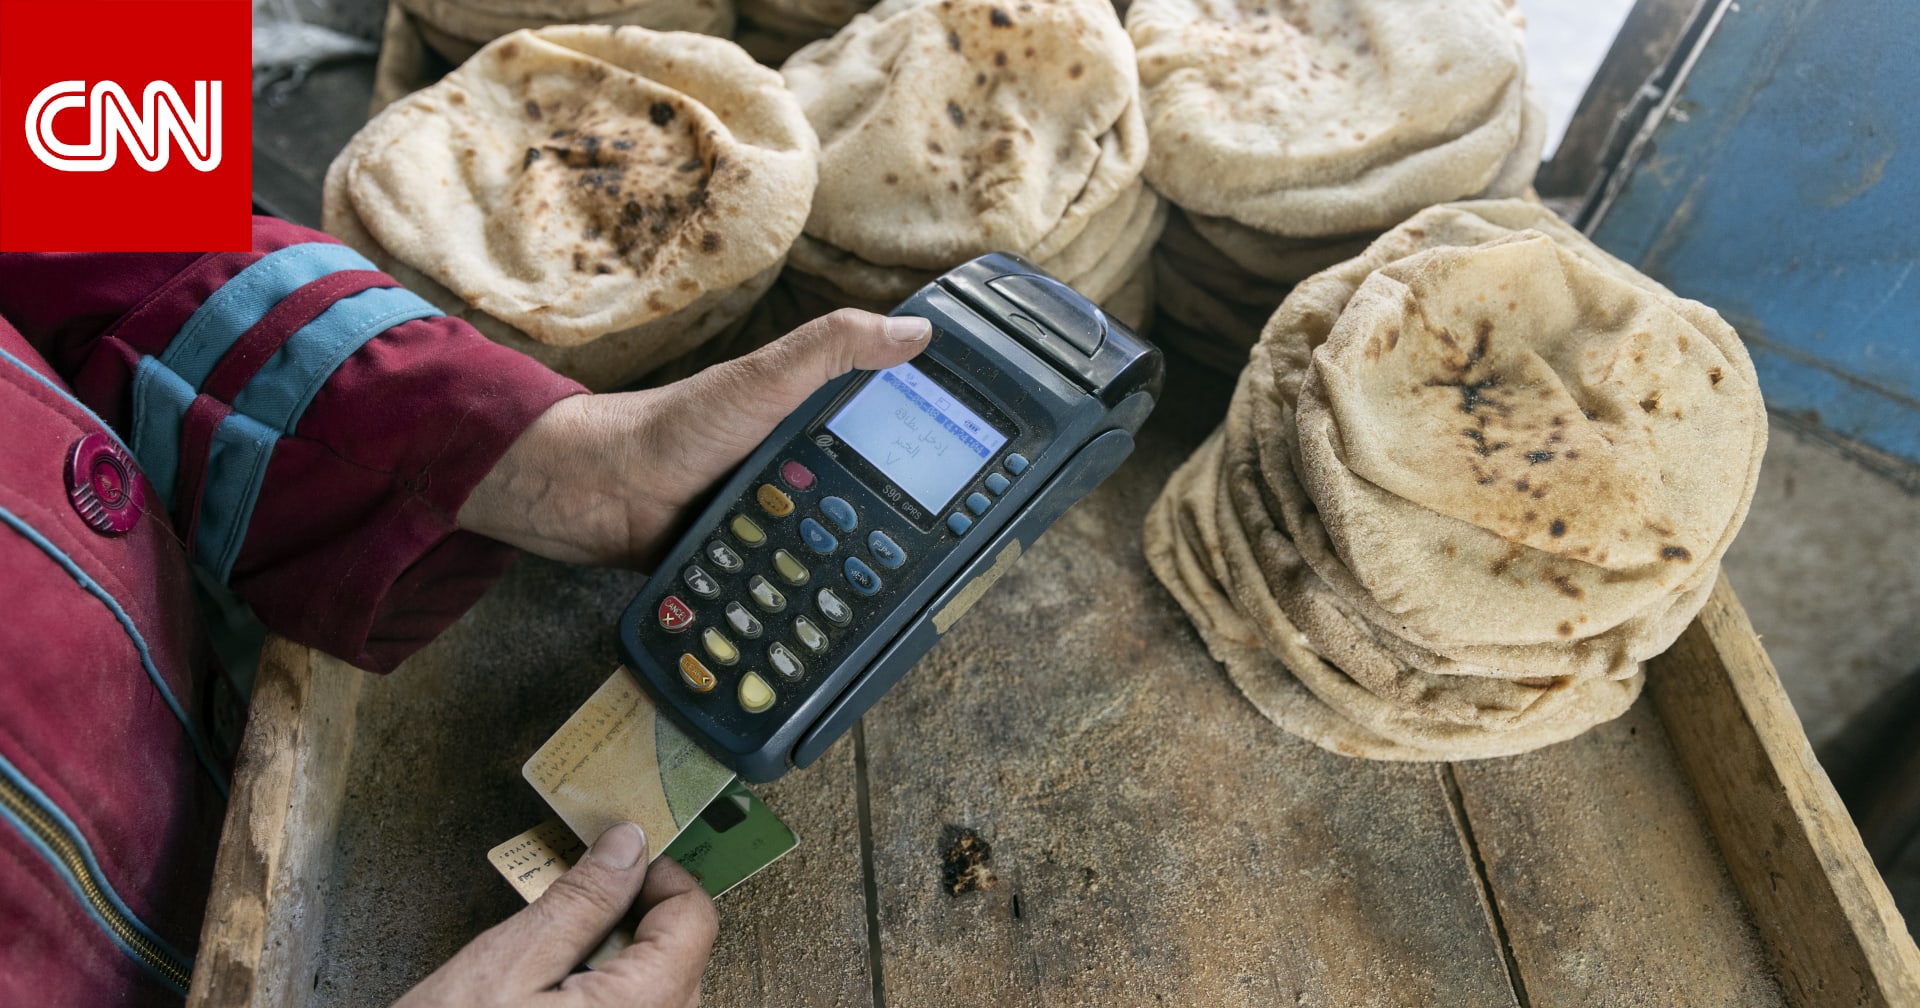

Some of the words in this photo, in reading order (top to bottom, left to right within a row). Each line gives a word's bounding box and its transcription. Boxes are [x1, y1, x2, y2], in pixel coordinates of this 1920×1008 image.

[882, 485, 902, 502] S90
[902, 502, 922, 520] GPRS
[664, 599, 687, 621] CANCEL
